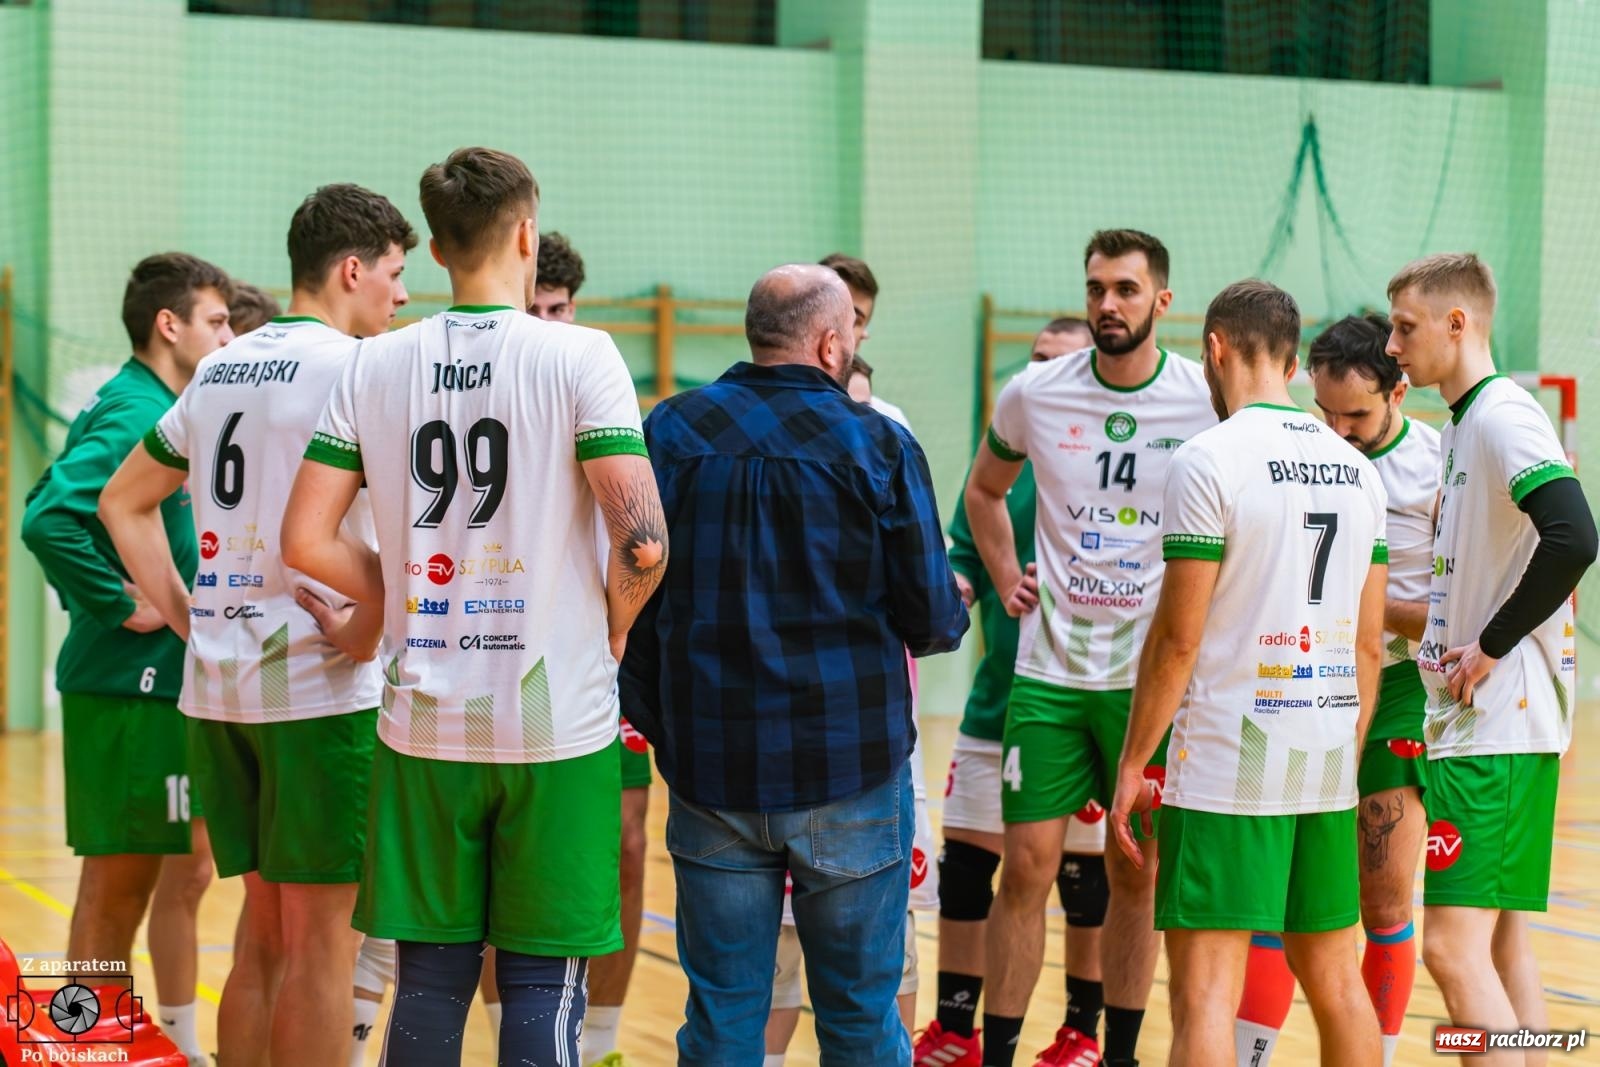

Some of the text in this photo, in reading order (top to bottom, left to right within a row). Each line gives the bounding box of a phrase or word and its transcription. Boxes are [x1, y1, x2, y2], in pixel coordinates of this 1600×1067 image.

[431, 359, 492, 394] JOŃCA
[211, 412, 245, 510] 6
[1095, 450, 1137, 493] 14
[411, 418, 509, 528] 99
[1267, 460, 1362, 489] BŁASZCZOK
[1066, 505, 1160, 527] VISON
[1303, 512, 1338, 604] 7
[1067, 575, 1147, 597] PIVEXIN
[1068, 593, 1144, 608] TECHNOLOGY
[482, 634, 519, 642] CONCEPT
[482, 642, 526, 650] automatic
[1258, 632, 1297, 646] radio
[139, 666, 157, 693] 6
[1254, 698, 1313, 708] UBEZPIECZENIA
[1255, 689, 1283, 699] MULTI
